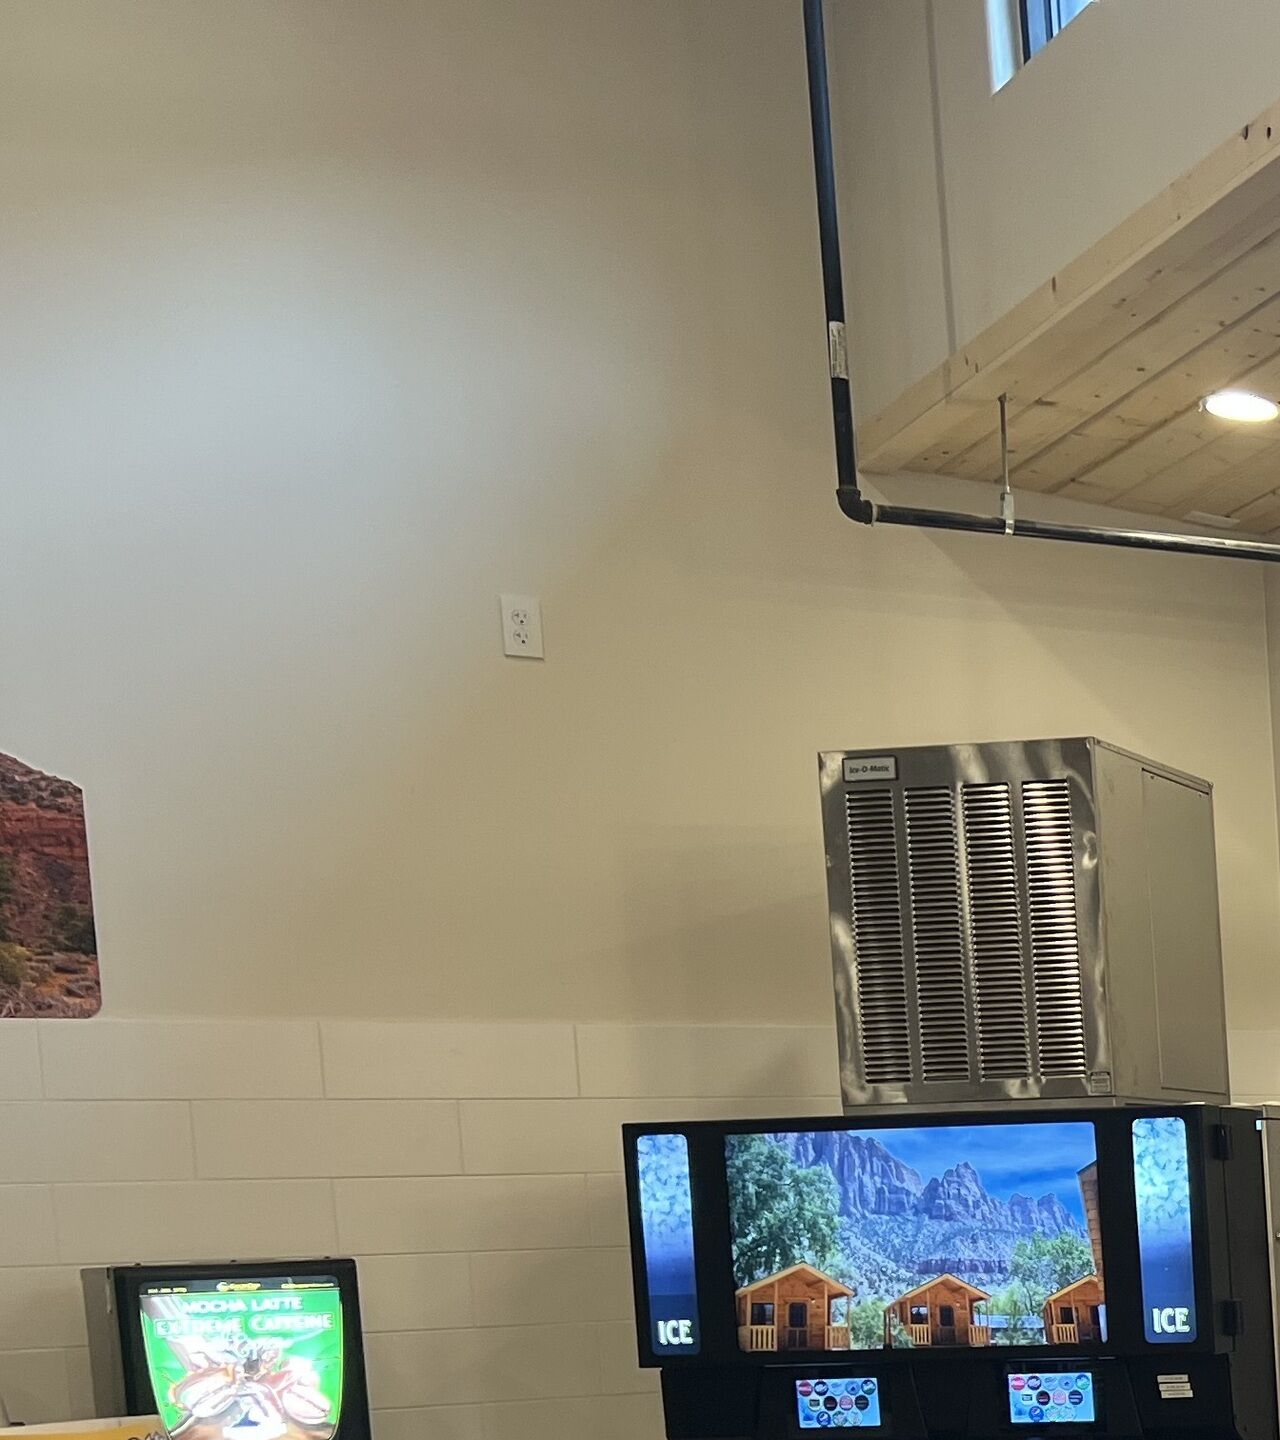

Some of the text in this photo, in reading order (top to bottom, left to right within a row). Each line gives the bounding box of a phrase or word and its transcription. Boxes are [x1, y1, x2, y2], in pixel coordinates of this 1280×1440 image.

[184, 1296, 303, 1314] MOCHA LATTE
[658, 1319, 693, 1346] ICE
[1152, 1307, 1191, 1334] ICE
